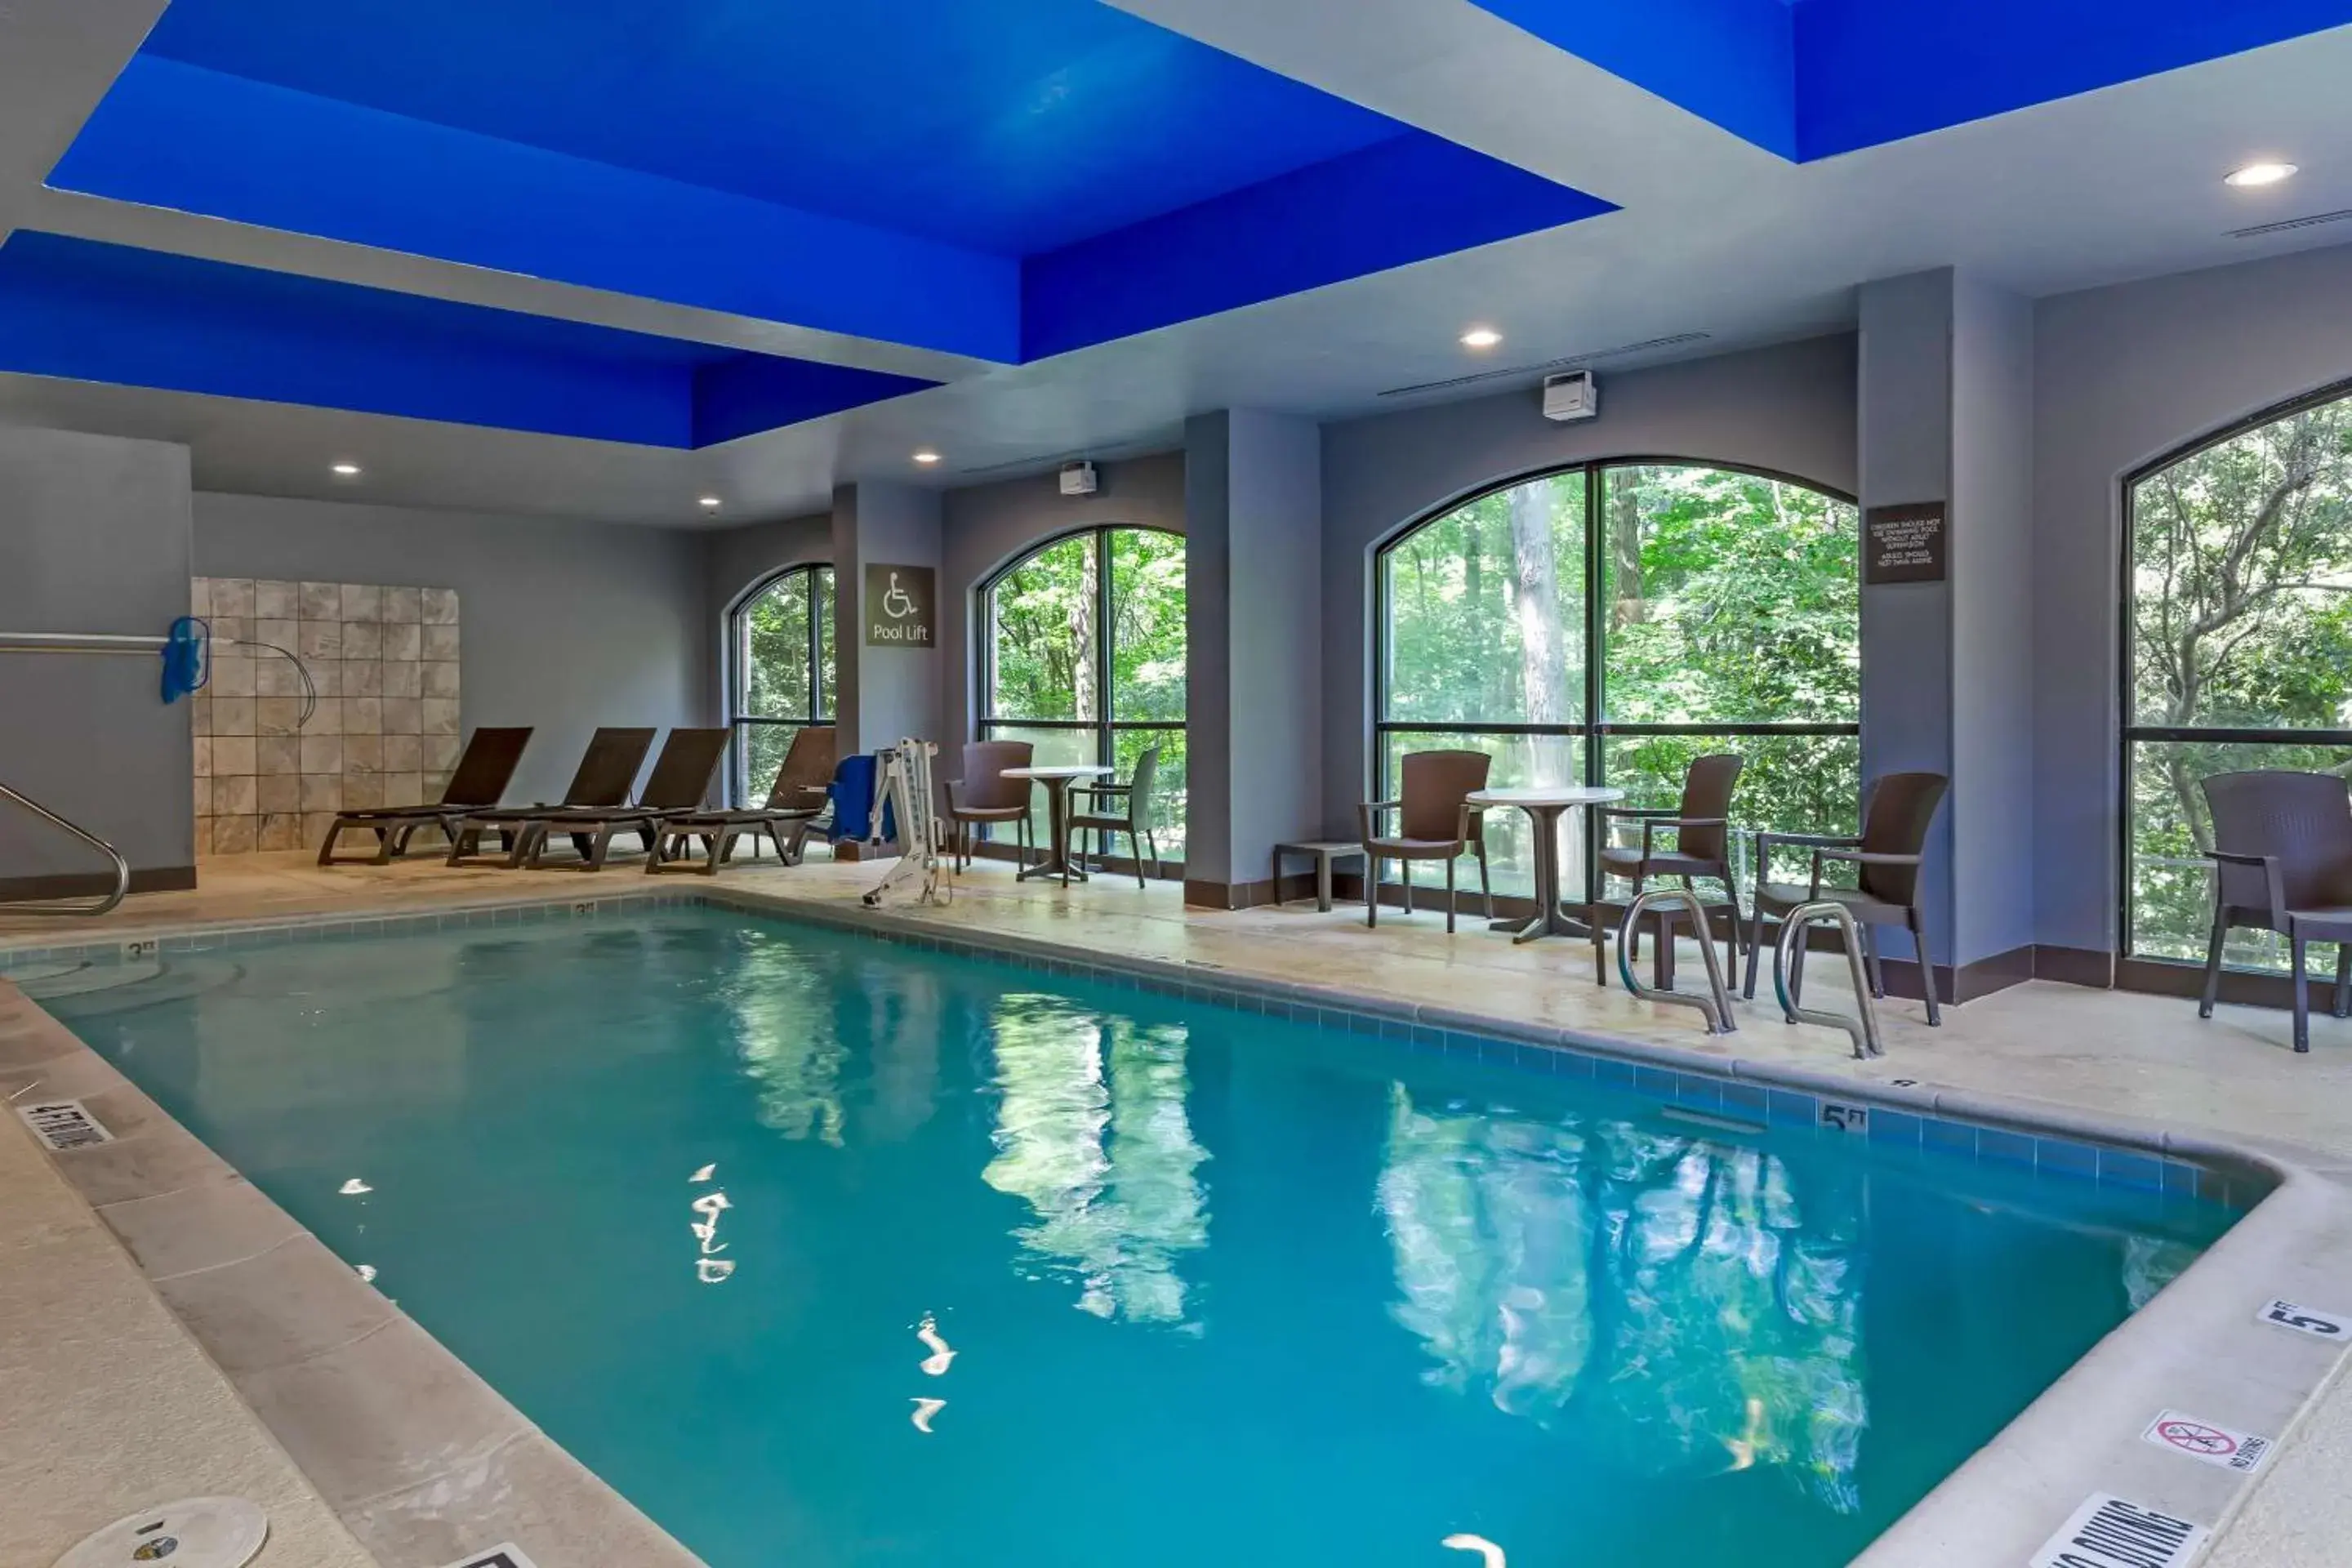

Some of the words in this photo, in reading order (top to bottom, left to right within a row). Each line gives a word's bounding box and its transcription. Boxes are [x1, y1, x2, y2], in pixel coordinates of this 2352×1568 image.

[874, 623, 902, 639] Pool
[906, 625, 929, 640] Lift
[2071, 1499, 2194, 1568] DIVING
